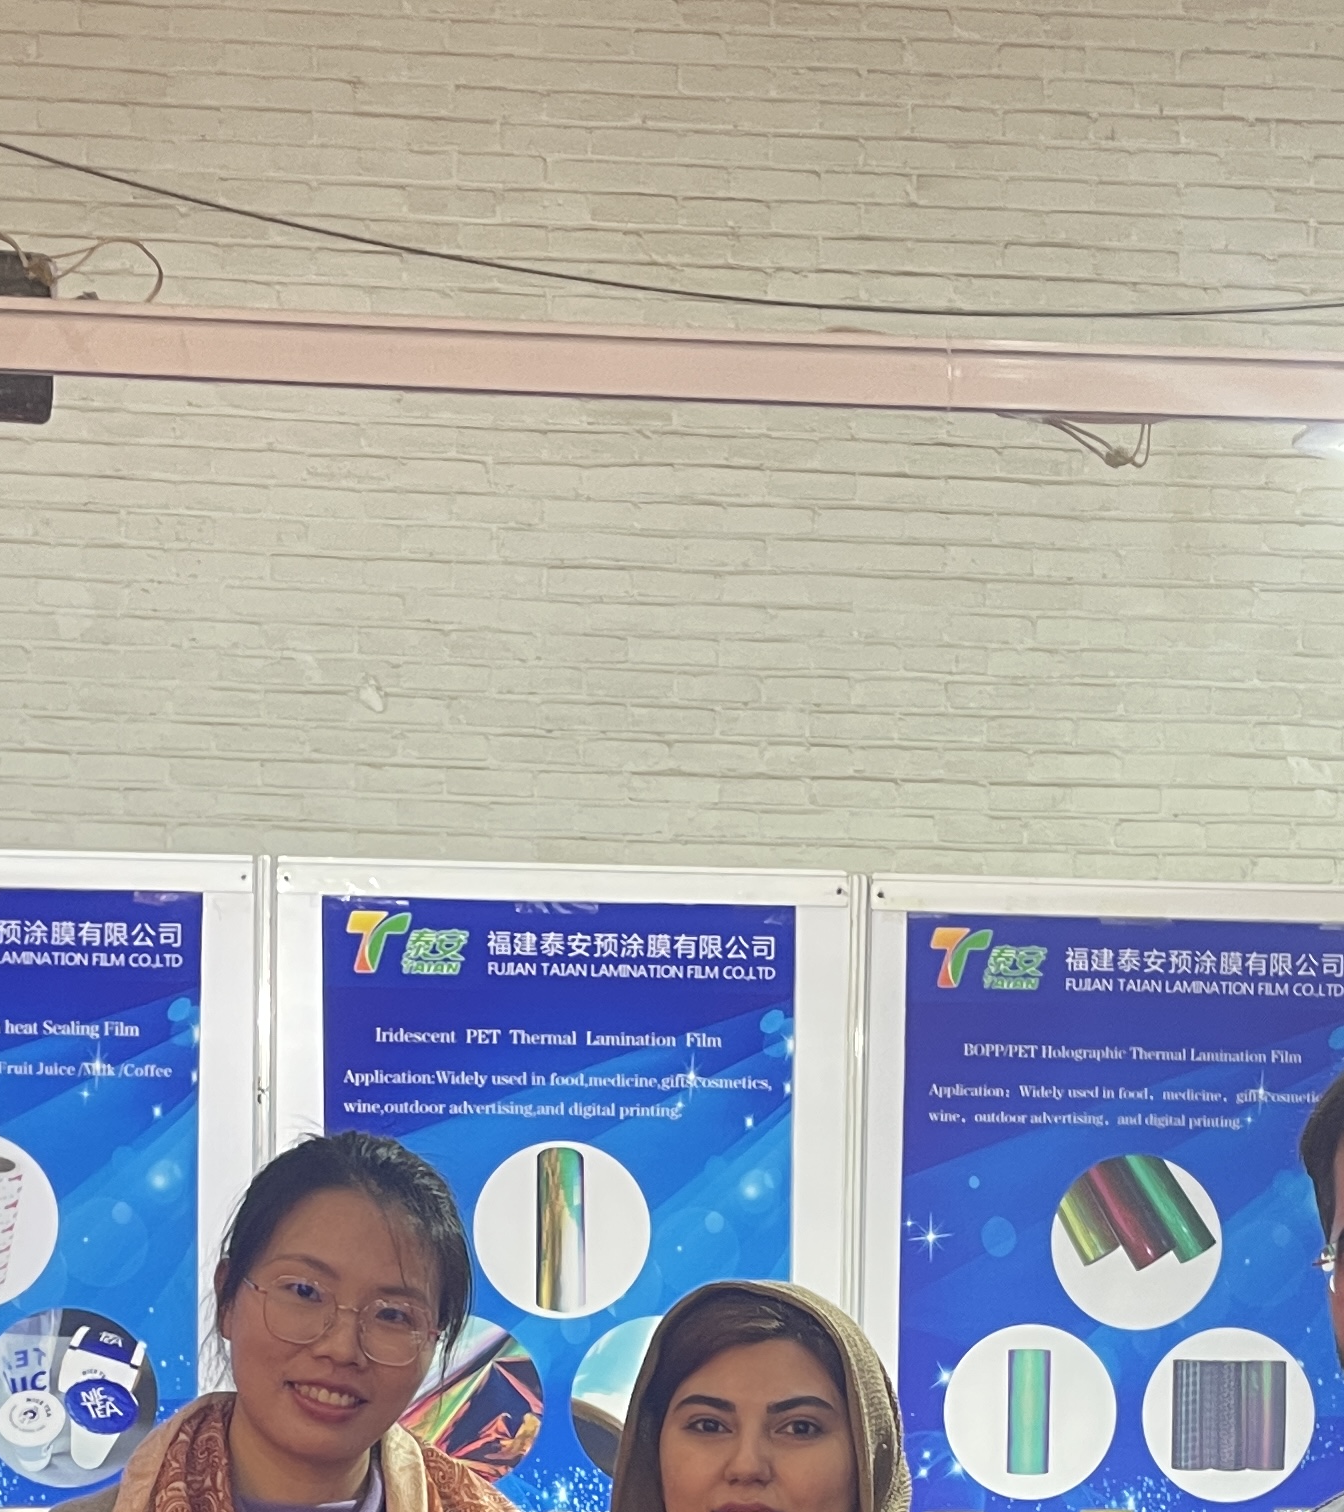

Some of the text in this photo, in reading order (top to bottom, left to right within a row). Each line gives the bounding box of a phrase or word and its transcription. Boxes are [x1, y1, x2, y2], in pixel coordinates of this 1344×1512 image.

[406, 928, 469, 961] 泰安
[487, 930, 776, 961] 福建泰安预涂膜有限公司
[92, 952, 125, 967] FILM
[401, 959, 461, 975] TAIAN
[988, 945, 1048, 977] 泰安
[1065, 947, 1344, 978] 福建泰安预涂膜有限公司
[487, 962, 537, 976] FUJIAN
[541, 963, 587, 977] TAIAN
[591, 964, 683, 979] LAMINATION
[687, 965, 719, 979] FILM
[1065, 978, 1113, 992] FUJIAN
[1118, 978, 1162, 993] TAIAN
[1165, 980, 1254, 996] LAMINATION
[1258, 981, 1289, 996] FILM
[5, 1020, 38, 1035] heat
[42, 1020, 99, 1039] Sealing
[104, 1021, 140, 1037] Film
[375, 1027, 722, 1048] Iridescent PET Thermal Lamination Film
[964, 1043, 1302, 1064] BOPP/PET Holographic Thermal Lamination Film
[36, 1062, 76, 1076] Juice
[118, 1063, 173, 1079] /Coffee
[492, 1072, 545, 1086] used in
[929, 1083, 1010, 1099] Application:
[1019, 1085, 1064, 1100] Widely
[1068, 1085, 1098, 1099] used
[1102, 1086, 1114, 1099] in
[568, 1102, 616, 1119] digital
[974, 1111, 1025, 1124] outdoor
[1117, 1113, 1141, 1126] and
[1145, 1114, 1186, 1129] digital
